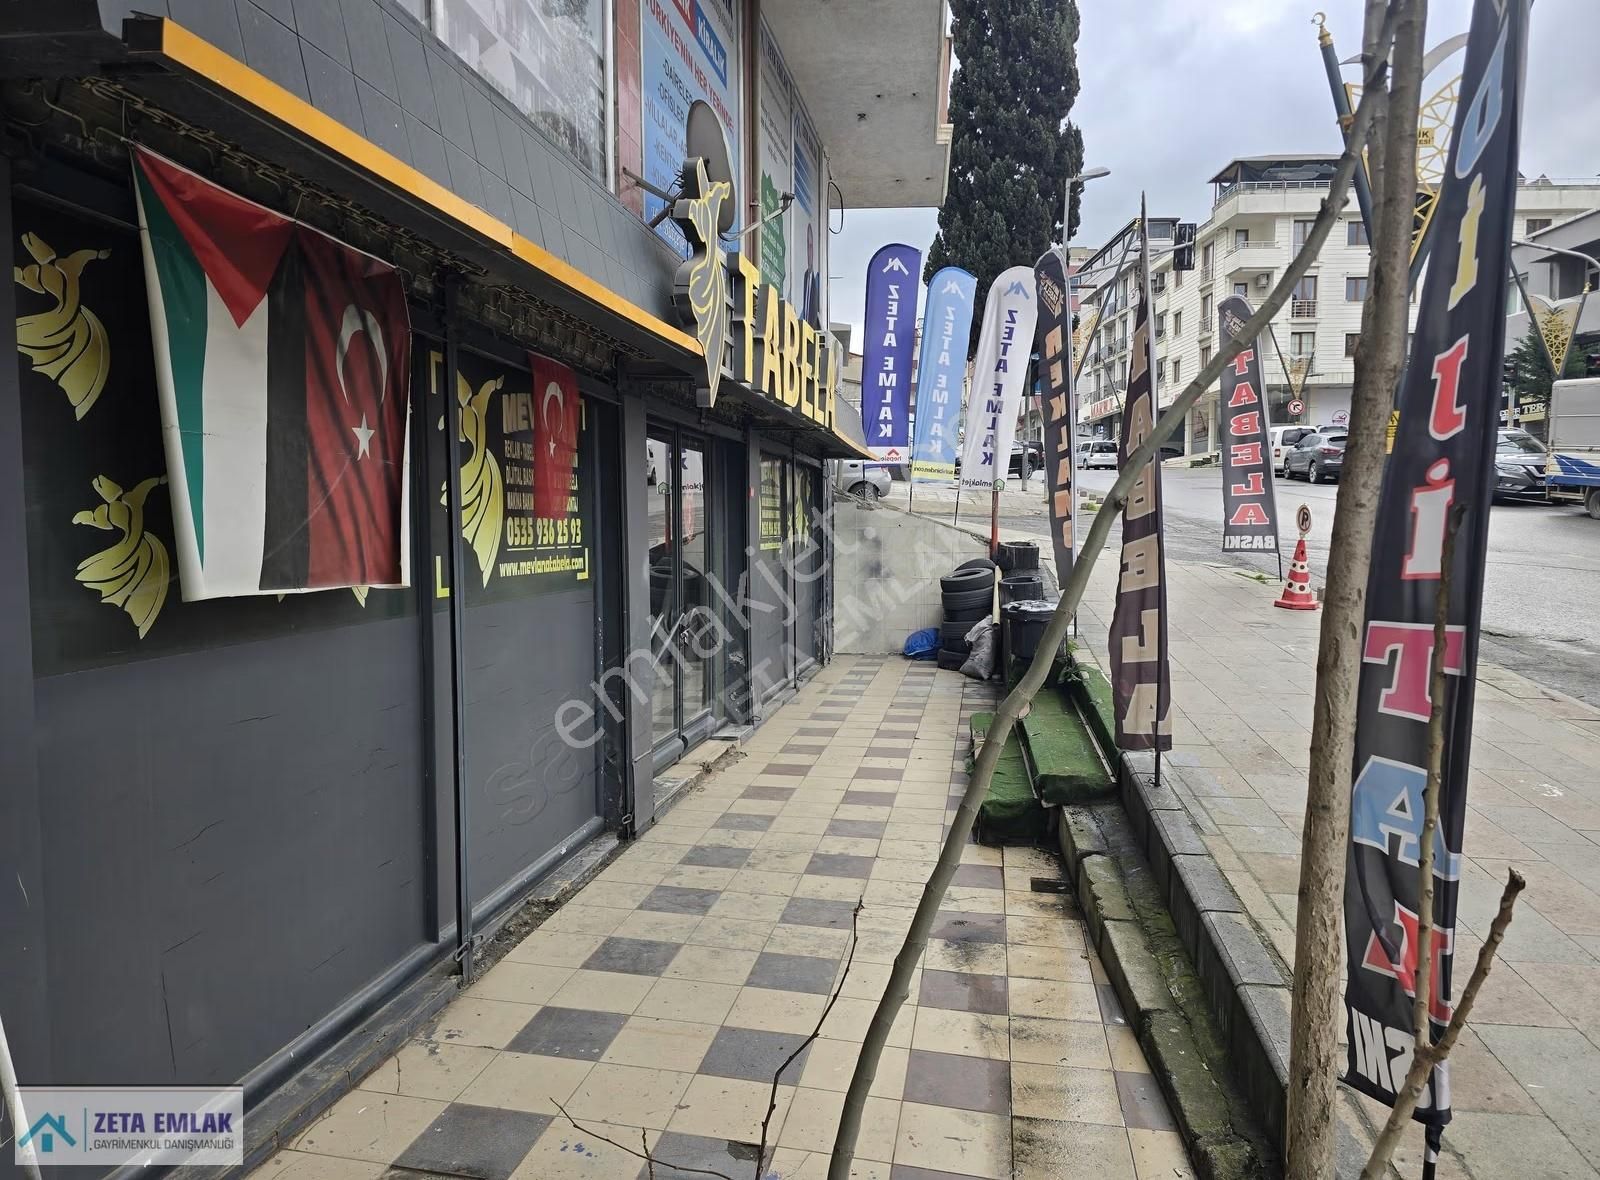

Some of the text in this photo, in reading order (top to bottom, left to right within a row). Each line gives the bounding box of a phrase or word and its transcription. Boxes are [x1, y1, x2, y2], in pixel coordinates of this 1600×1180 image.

[738, 251, 836, 432] TABELA
[506, 518, 582, 546] 0535 936 25 93
